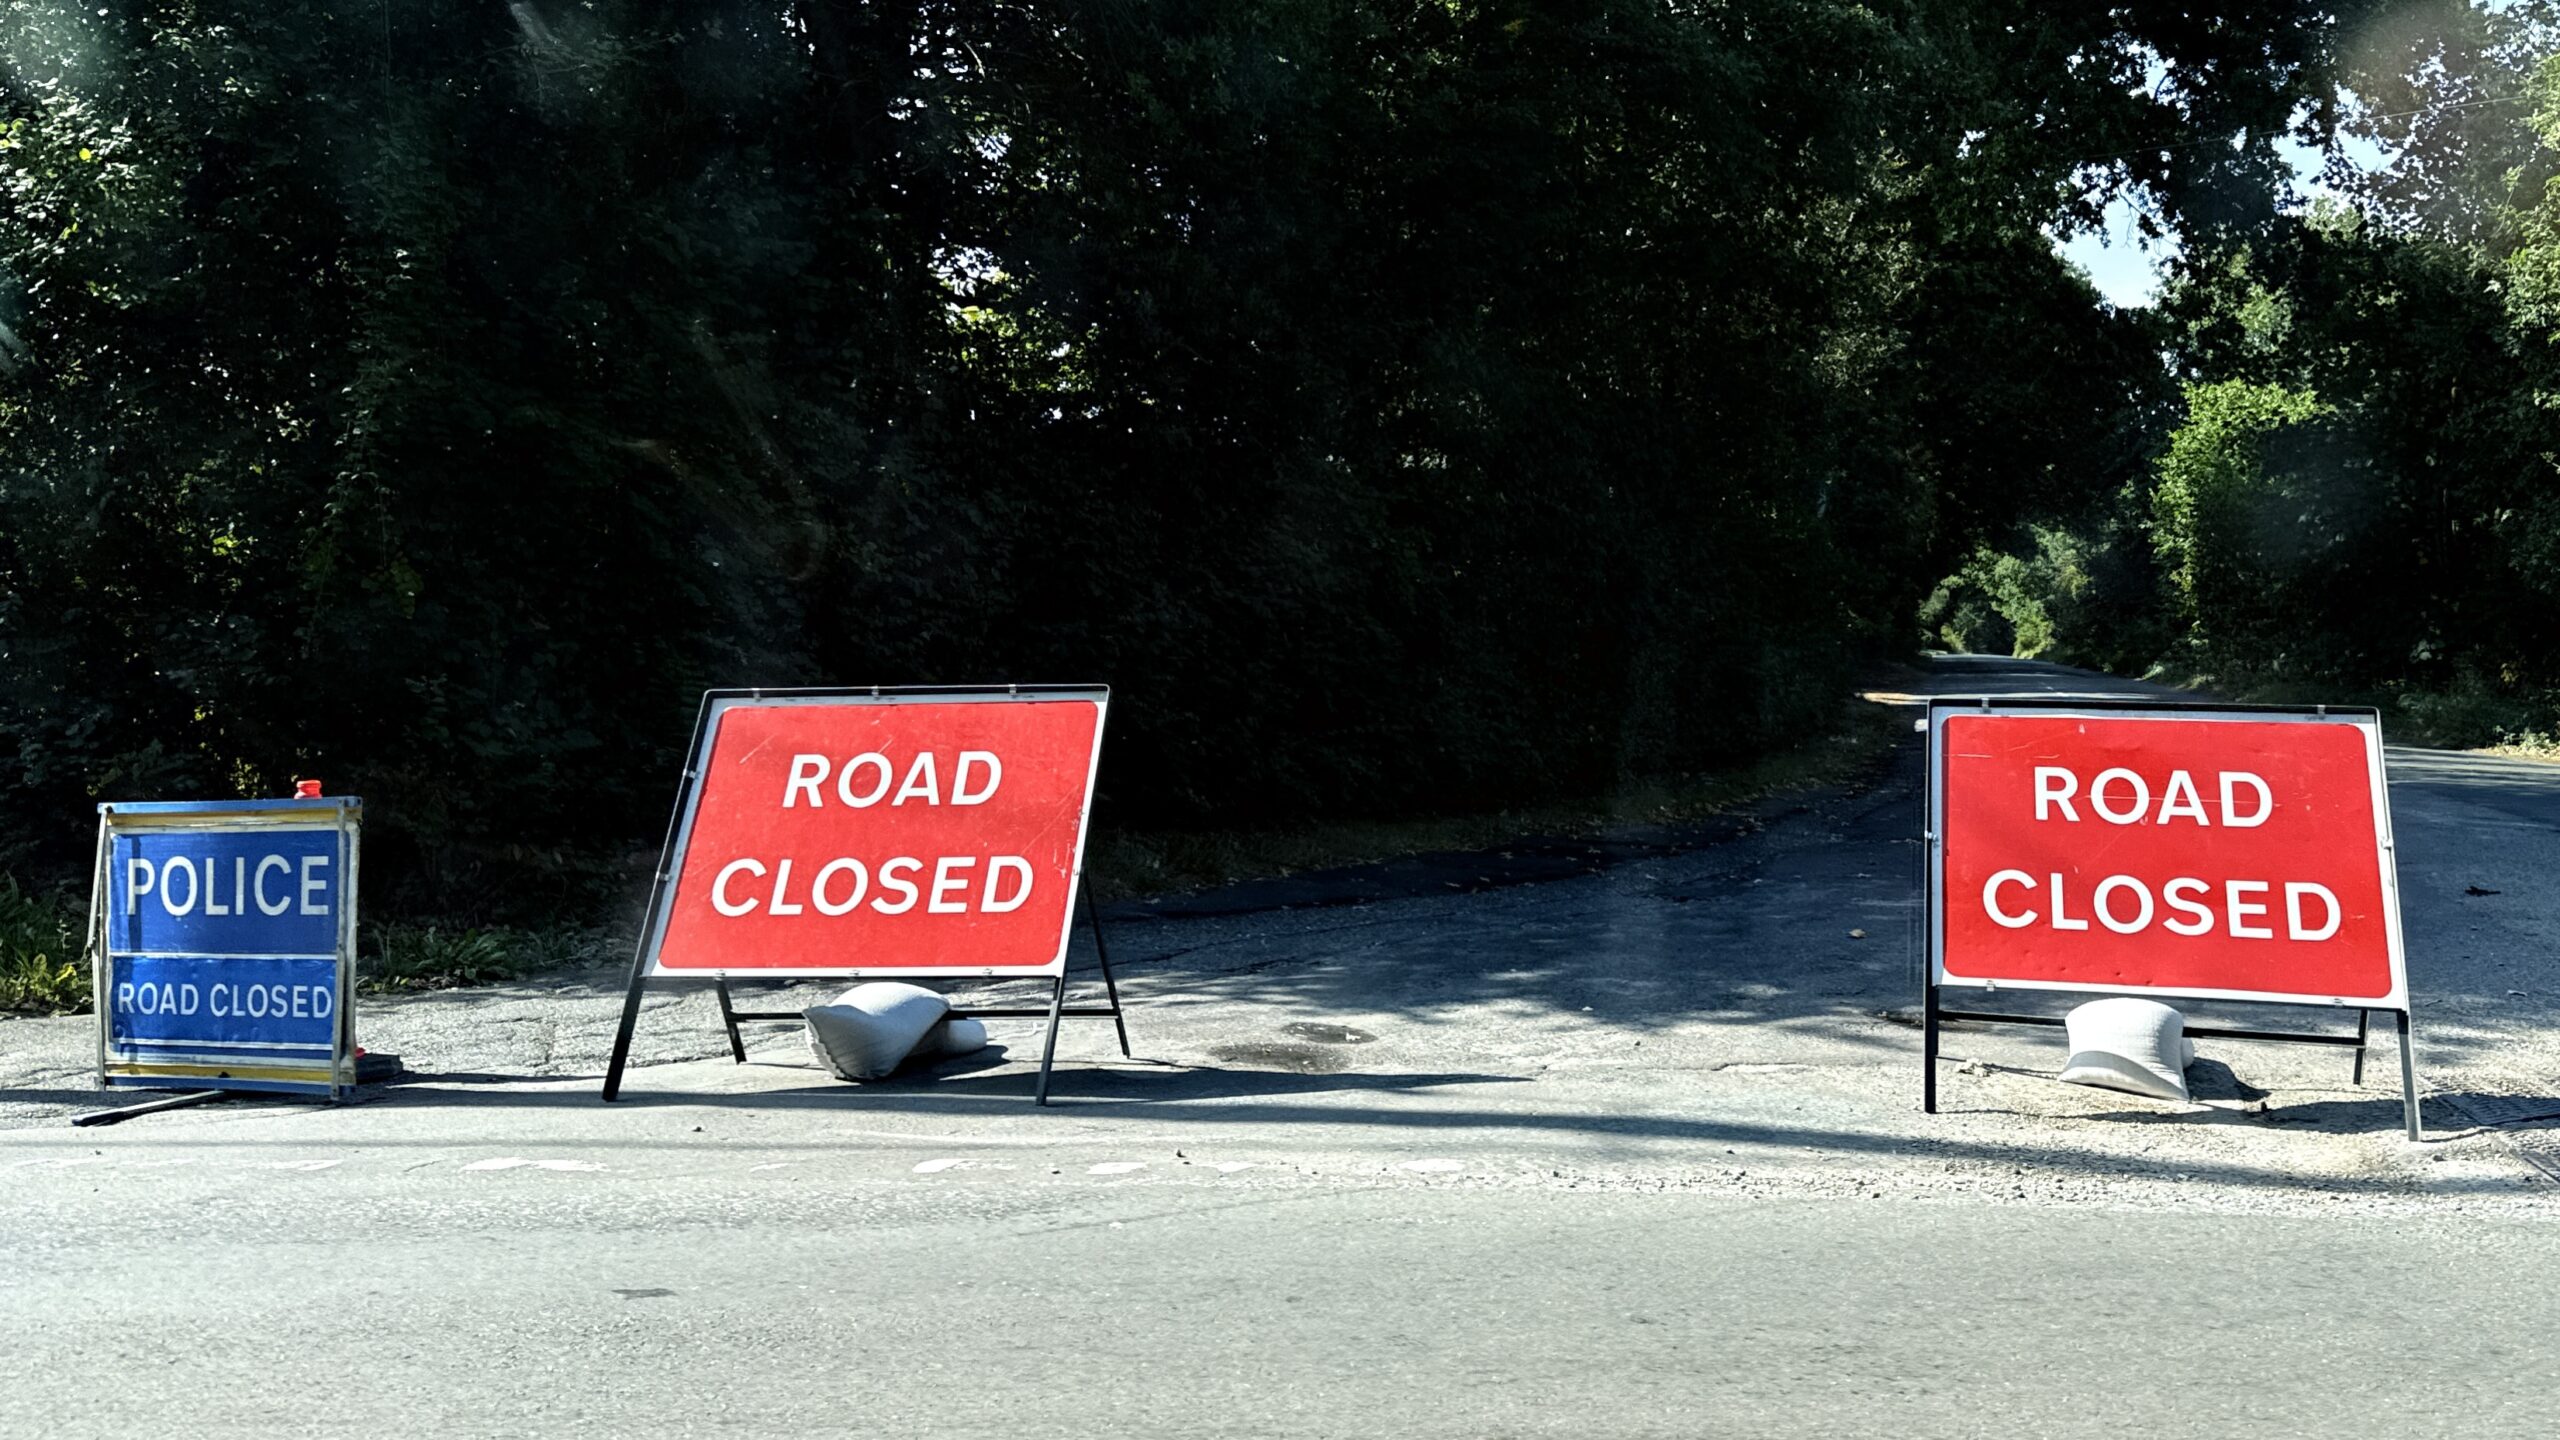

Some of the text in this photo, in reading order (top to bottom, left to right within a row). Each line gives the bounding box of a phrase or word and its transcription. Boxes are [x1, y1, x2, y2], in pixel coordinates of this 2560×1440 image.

[782, 750, 1002, 808] ROAD
[2033, 766, 2273, 828] ROAD
[126, 854, 329, 916] POLICE
[711, 855, 1034, 917] CLOSED
[1982, 869, 2342, 942] CLOSED
[118, 982, 332, 1018] ROAD CLOSED
